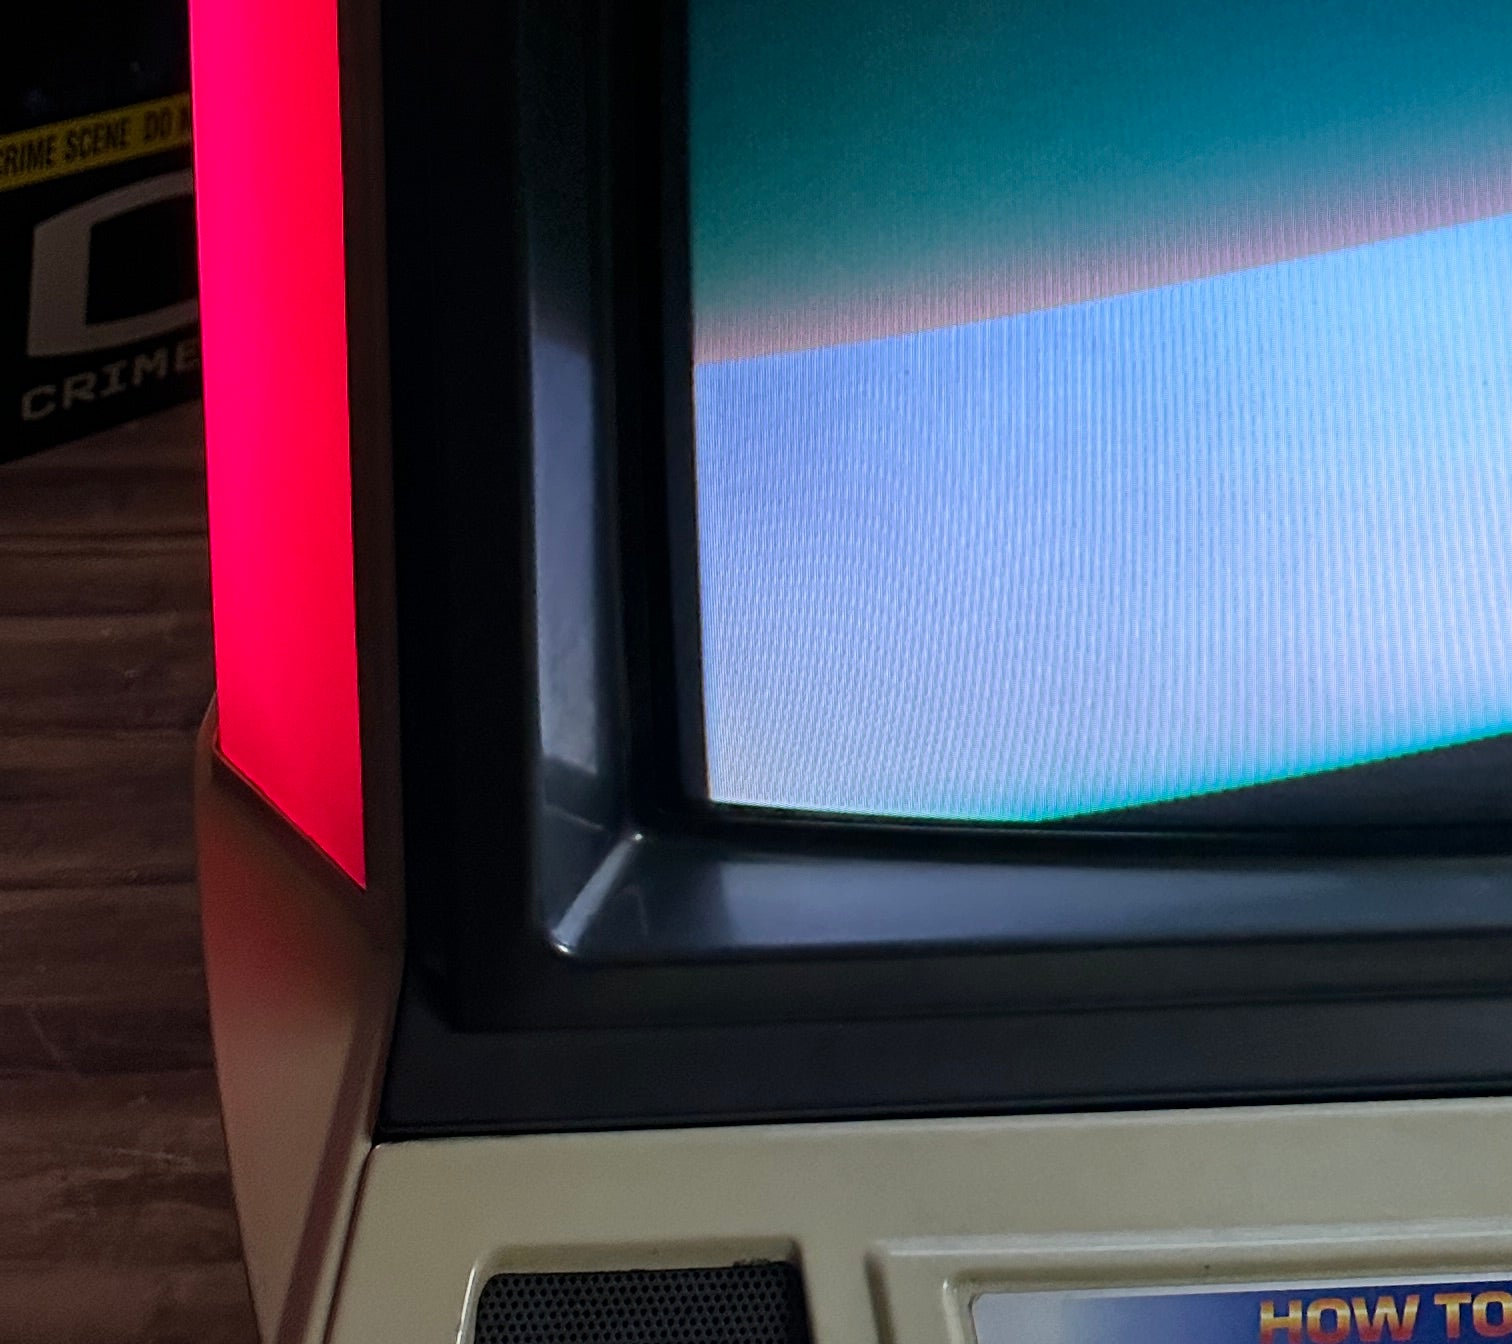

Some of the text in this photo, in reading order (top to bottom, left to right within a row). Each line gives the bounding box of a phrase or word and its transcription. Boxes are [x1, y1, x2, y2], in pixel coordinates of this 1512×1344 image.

[0, 134, 57, 175] RIME
[62, 121, 128, 163] SCENE
[1258, 1294, 1421, 1344] HOW
